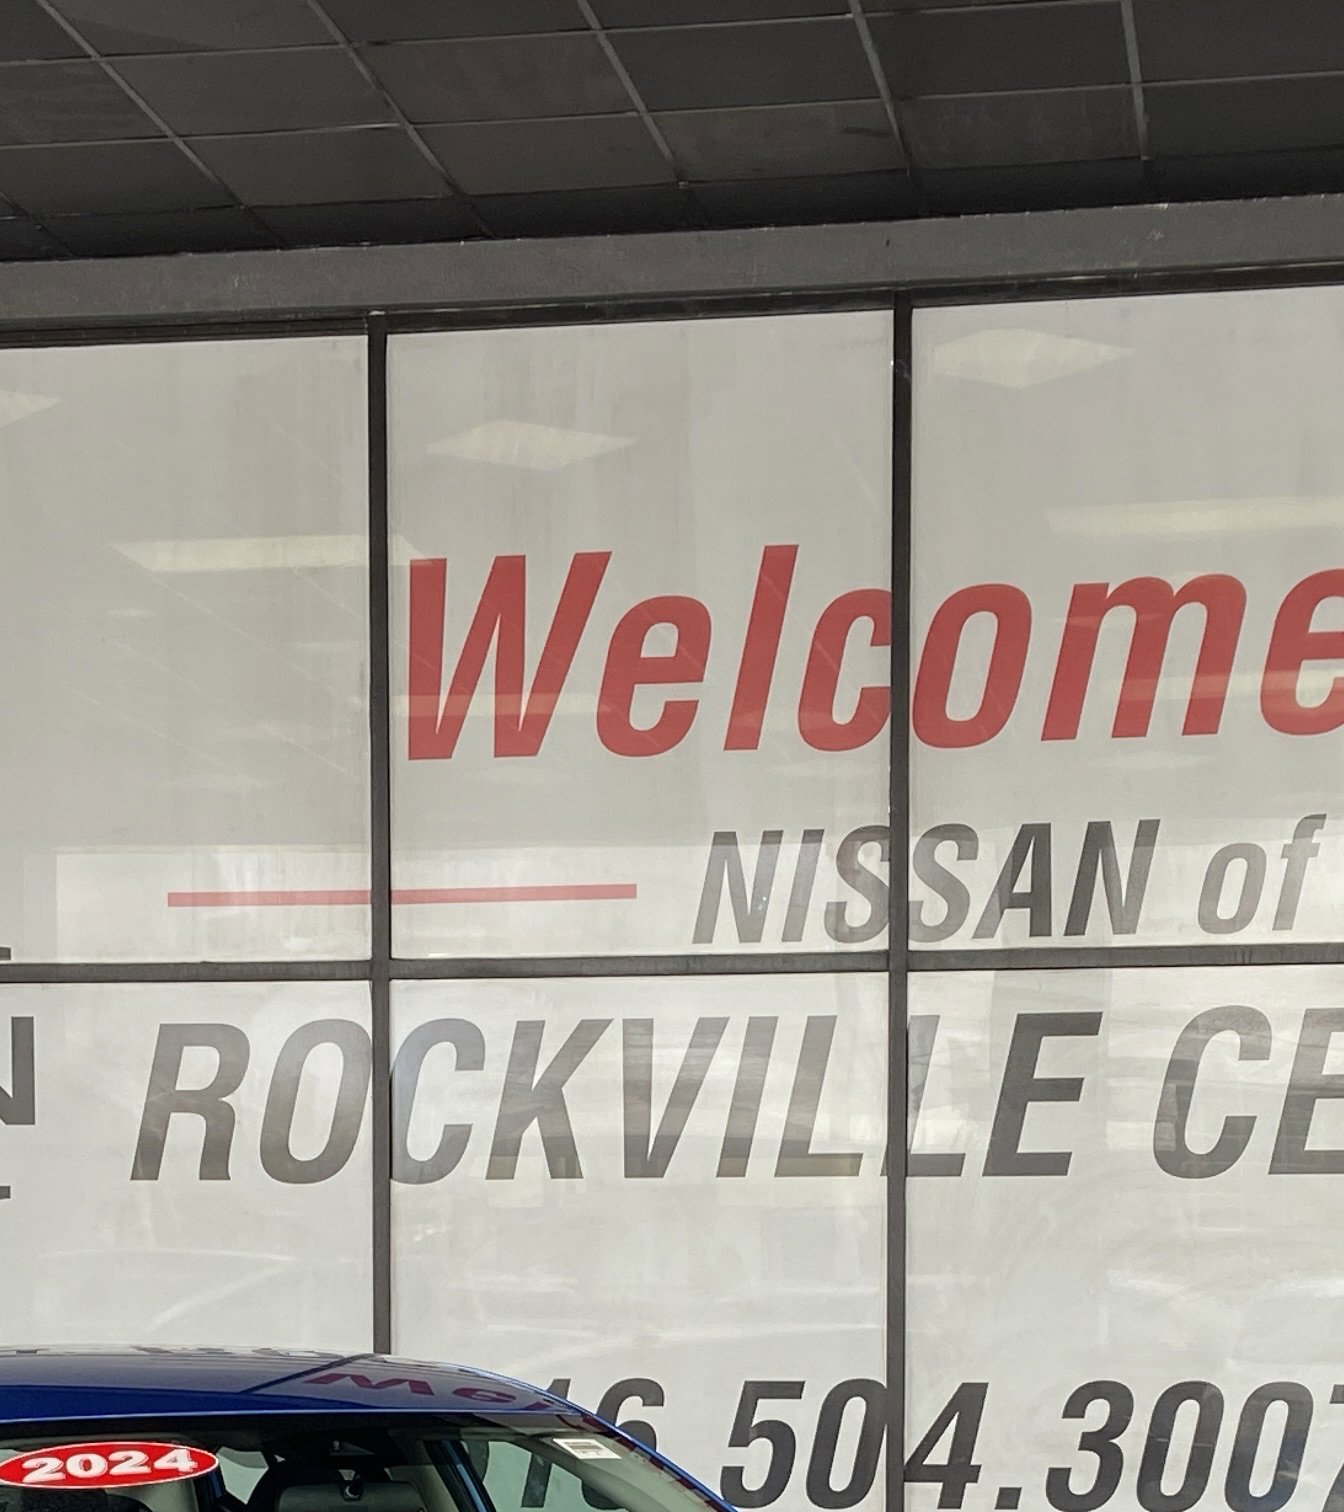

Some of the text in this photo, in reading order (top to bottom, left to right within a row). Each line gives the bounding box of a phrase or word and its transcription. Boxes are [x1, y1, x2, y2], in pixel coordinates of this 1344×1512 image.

[692, 814, 1327, 945] NISSAN of
[129, 1011, 1105, 1185] ROCKVILLE
[21, 1447, 199, 1483] 2024
